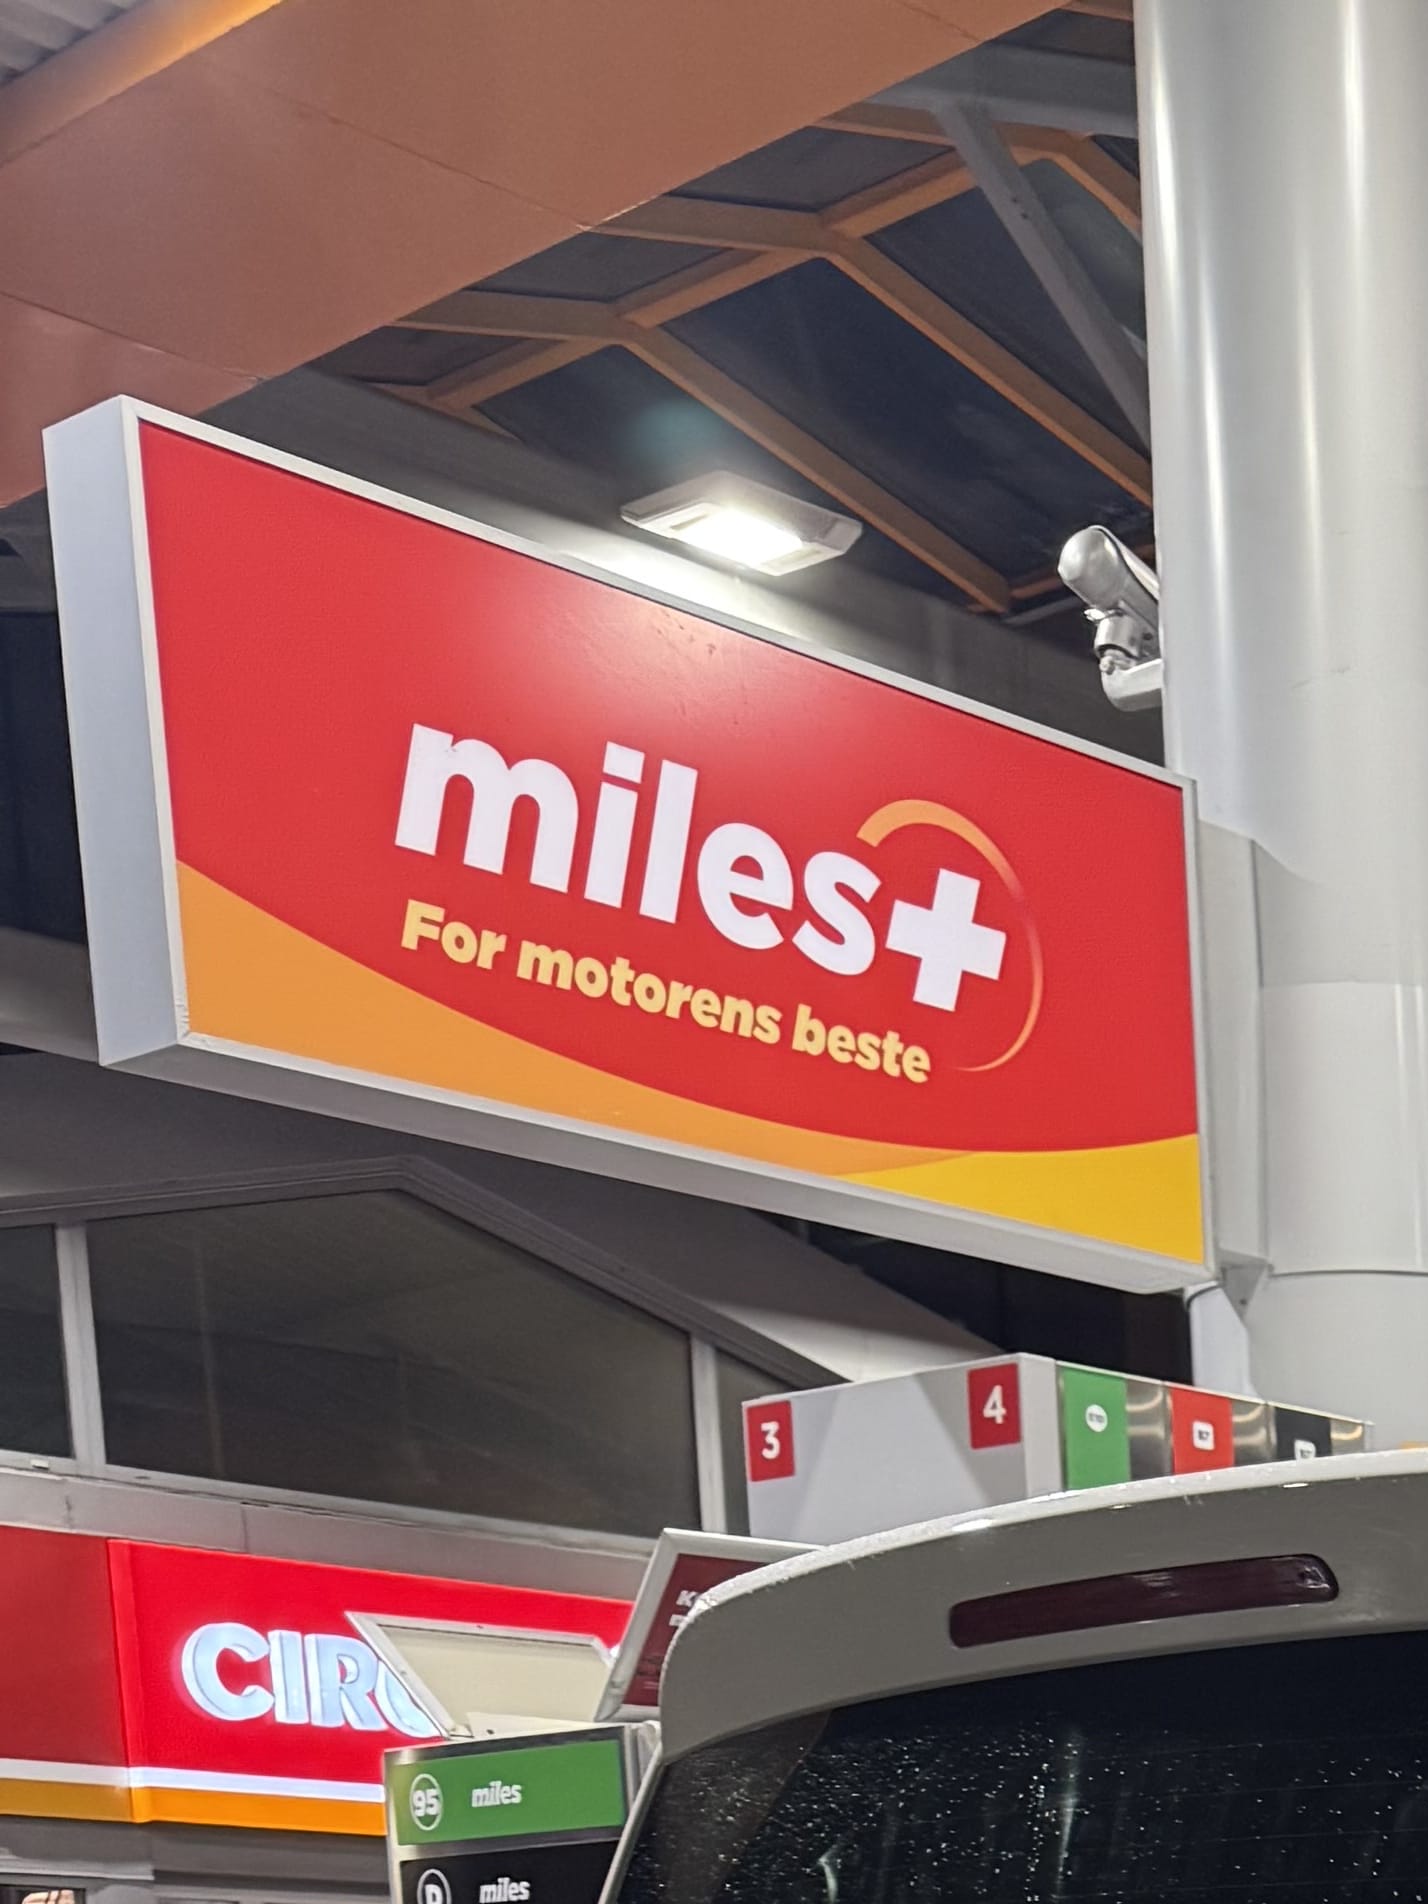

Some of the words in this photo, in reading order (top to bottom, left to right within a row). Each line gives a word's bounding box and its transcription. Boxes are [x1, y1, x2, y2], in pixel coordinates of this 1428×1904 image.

[394, 722, 1006, 1012] miles+
[400, 900, 506, 974] For
[516, 938, 783, 1047] motorens
[790, 1003, 932, 1083] beste
[984, 1385, 1007, 1424] 4
[761, 1421, 781, 1461] 3
[413, 1790, 440, 1817] 95
[471, 1780, 522, 1808] miles
[479, 1877, 531, 1904] miles
